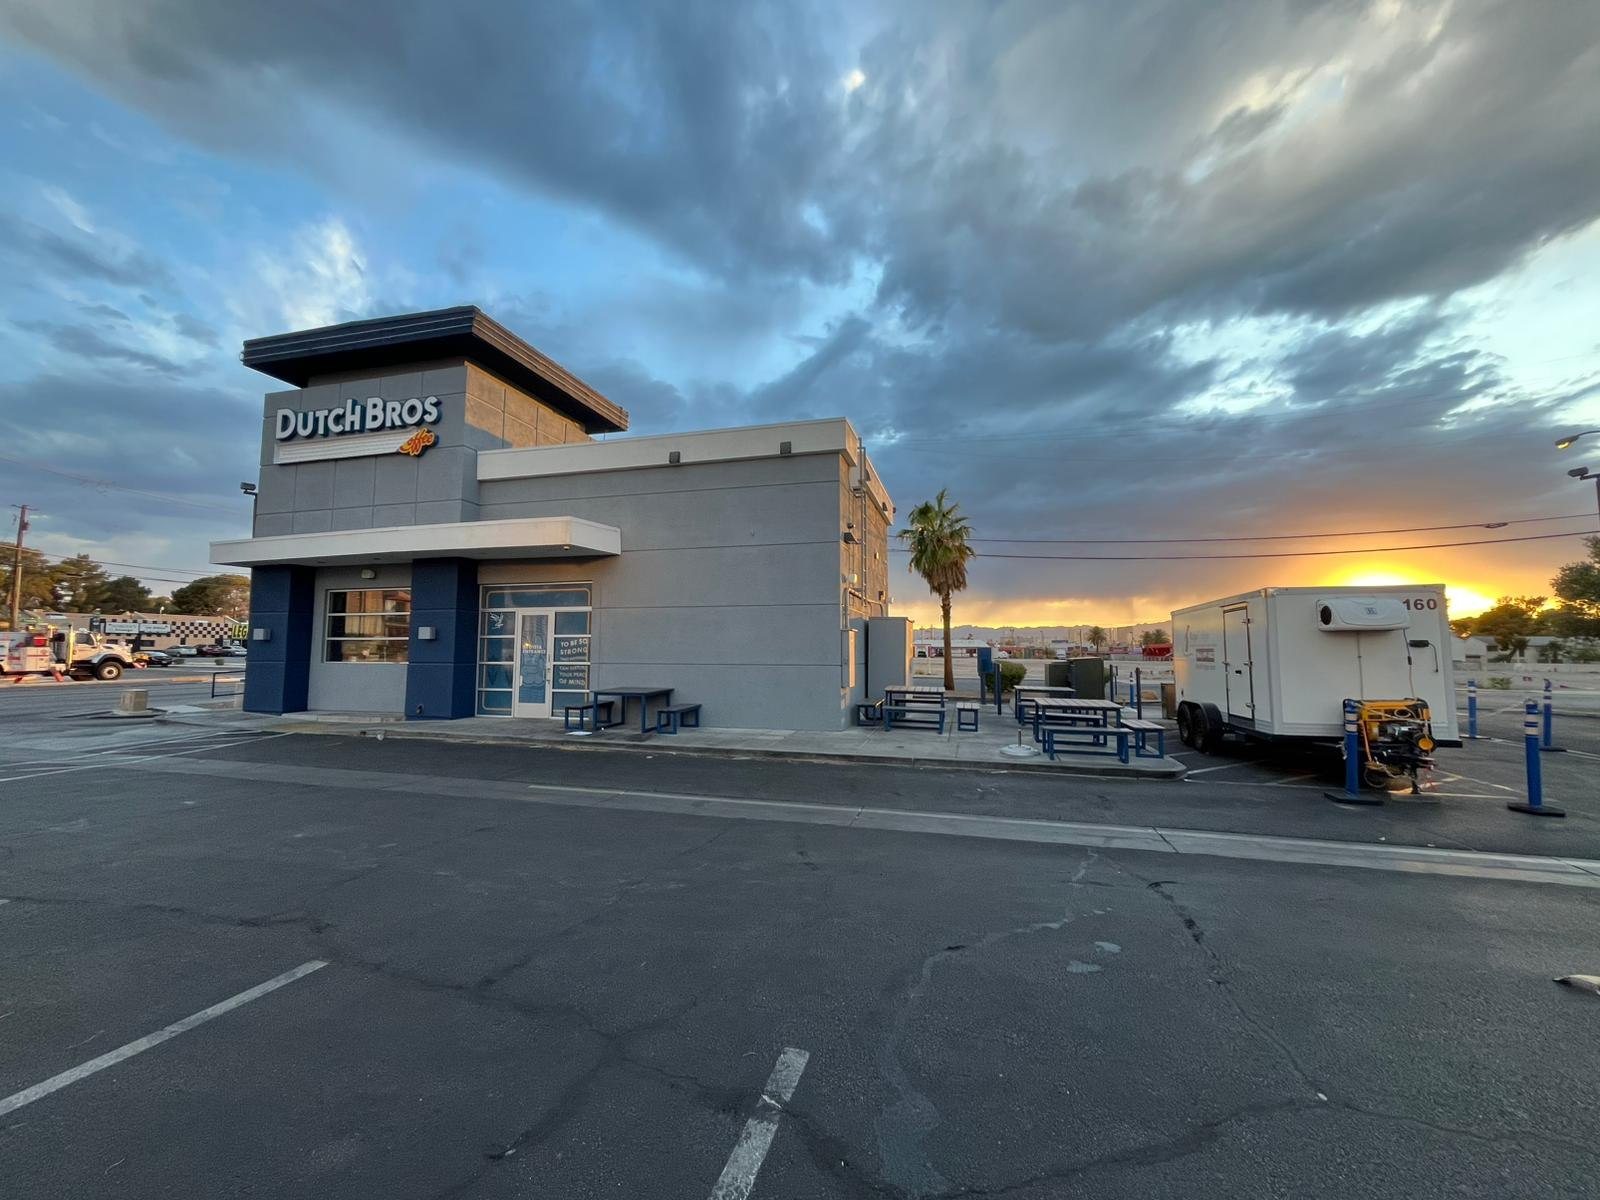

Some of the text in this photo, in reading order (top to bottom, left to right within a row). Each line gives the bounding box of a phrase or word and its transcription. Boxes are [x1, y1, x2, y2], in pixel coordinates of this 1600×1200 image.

[275, 395, 440, 440] DUTCH BROS
[1402, 598, 1437, 611] 160
[560, 647, 587, 655] STRONG
